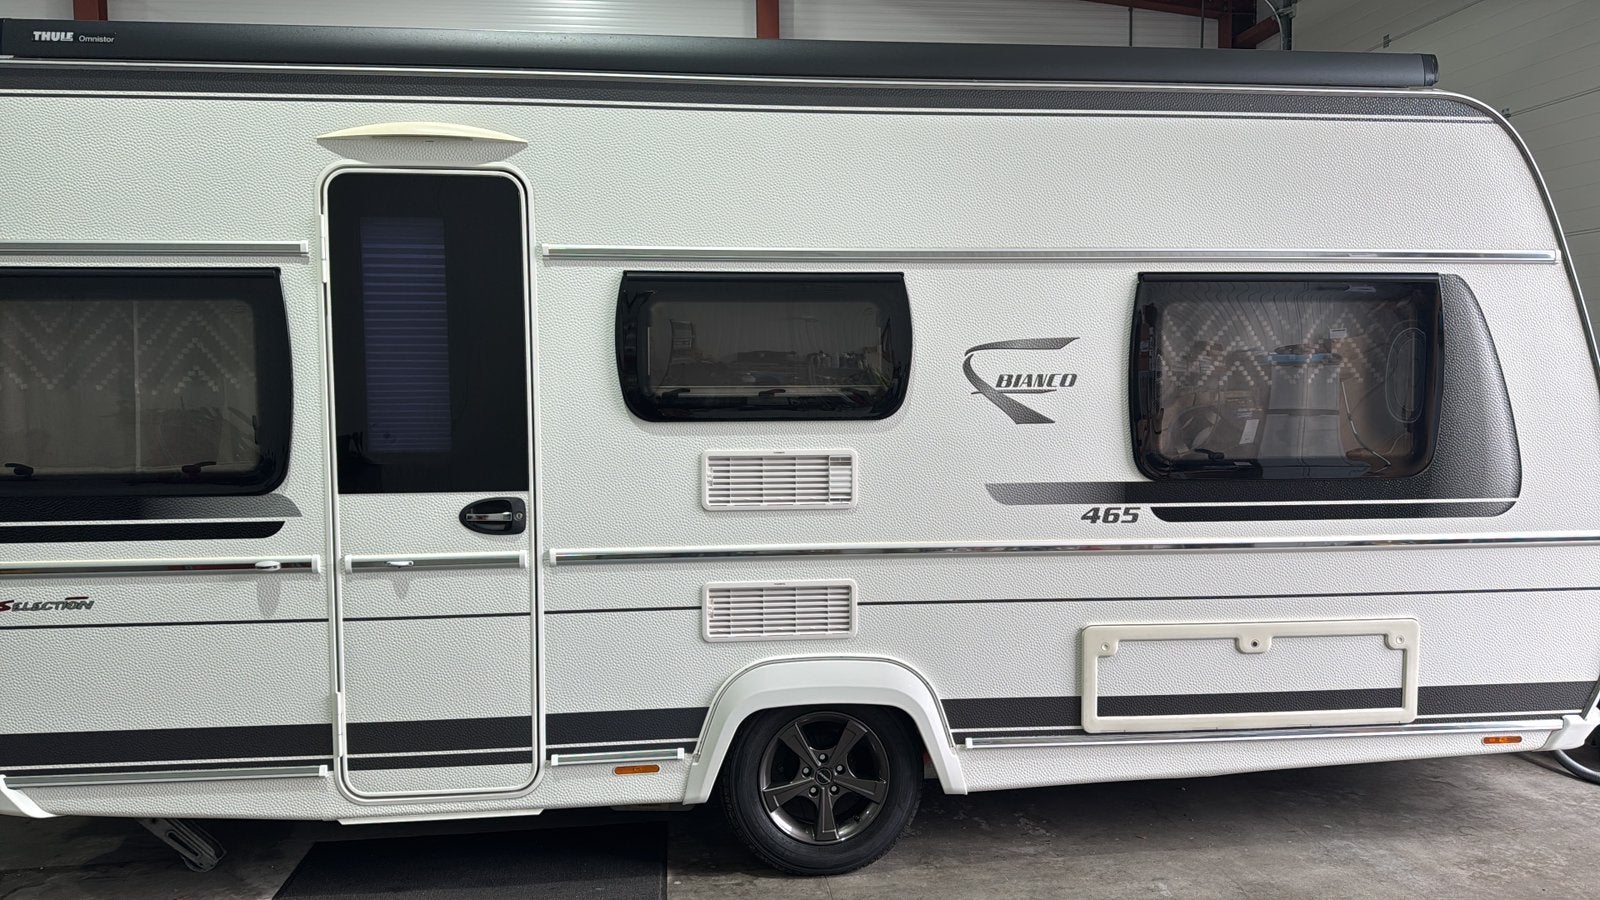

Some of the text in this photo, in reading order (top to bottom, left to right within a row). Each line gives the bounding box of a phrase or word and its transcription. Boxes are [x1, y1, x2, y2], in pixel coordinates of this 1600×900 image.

[33, 31, 115, 43] THULE Omnistor
[996, 373, 1078, 388] BIANCO
[1080, 507, 1141, 524] 465
